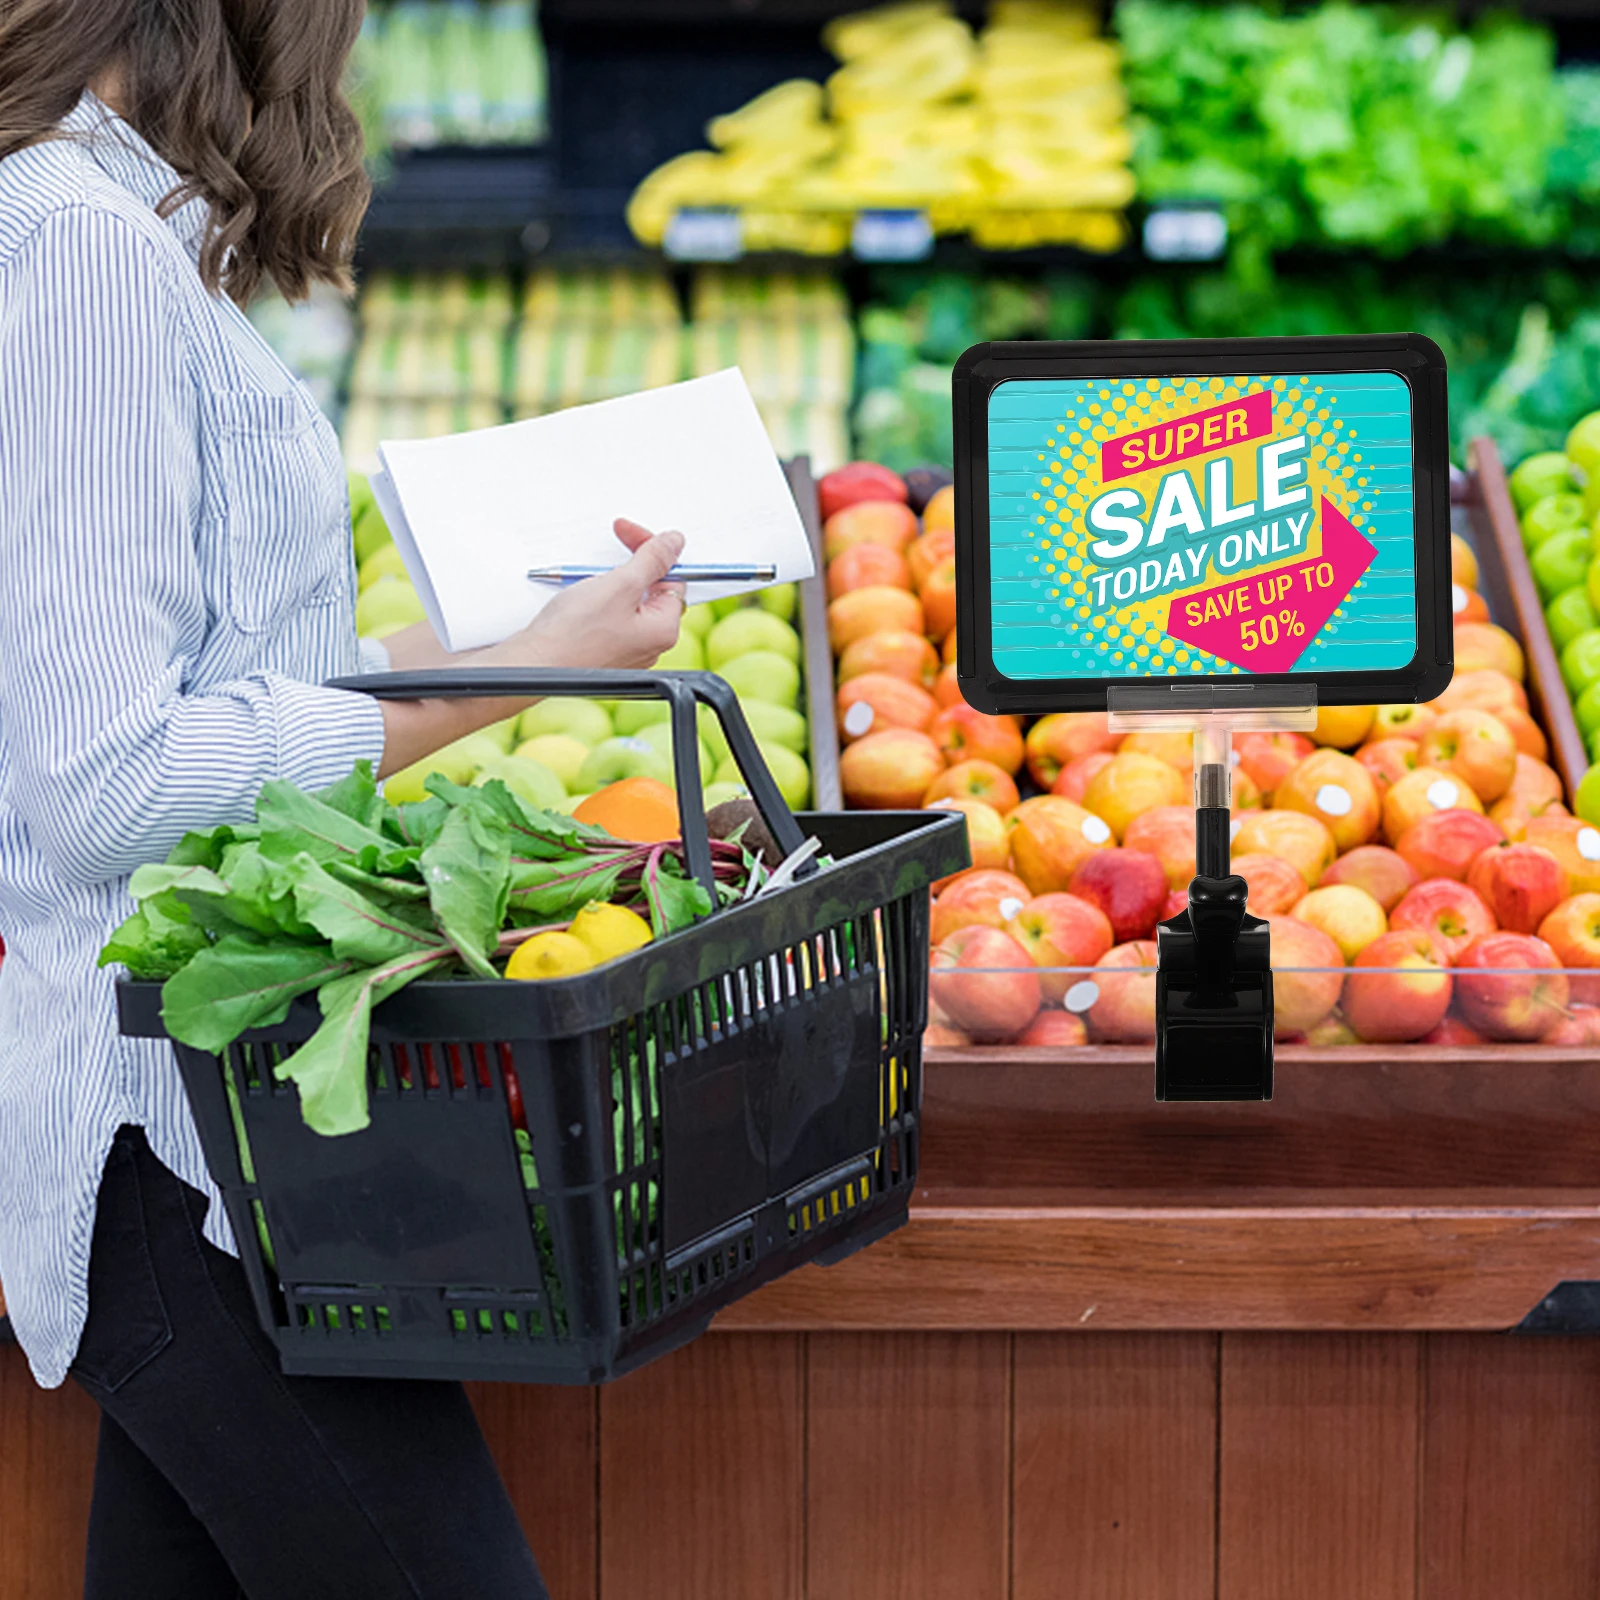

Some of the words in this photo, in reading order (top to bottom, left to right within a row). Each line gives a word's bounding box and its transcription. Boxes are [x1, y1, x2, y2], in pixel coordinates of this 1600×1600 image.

[1121, 408, 1248, 470] SUPER
[1091, 435, 1308, 559] SALE
[1091, 546, 1208, 607] TODAY
[1220, 512, 1311, 569] ONLY
[1184, 585, 1251, 627] SAVE
[1257, 573, 1293, 607] UP
[1300, 562, 1335, 594] TO
[1240, 608, 1305, 652] 50%
